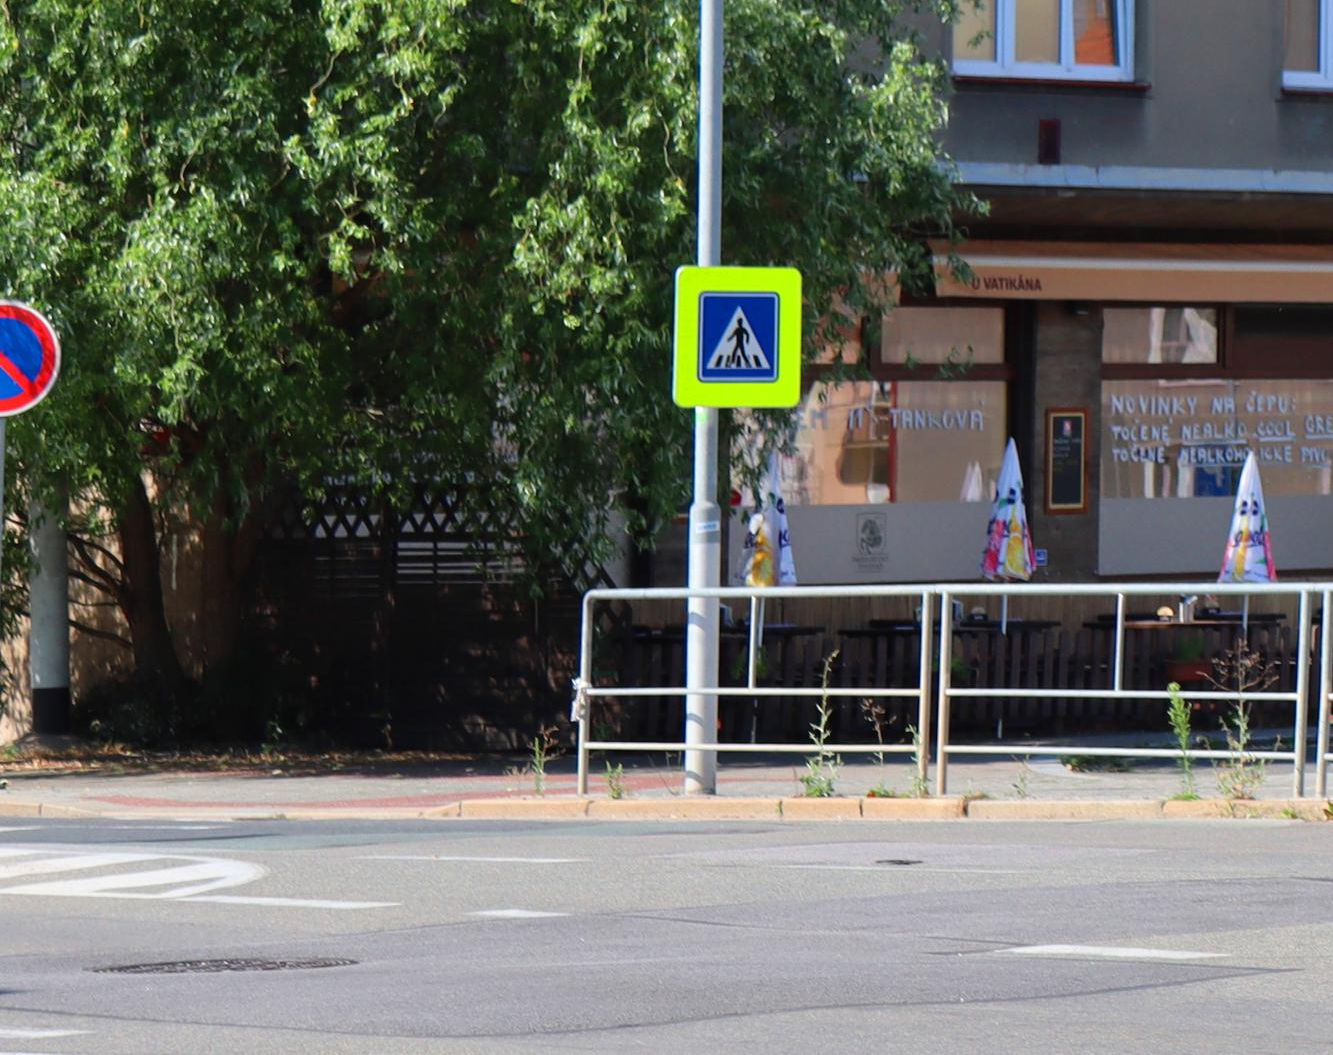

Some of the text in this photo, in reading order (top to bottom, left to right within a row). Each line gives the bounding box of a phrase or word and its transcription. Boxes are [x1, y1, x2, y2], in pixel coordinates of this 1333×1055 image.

[970, 274, 1042, 291] U VATIKÁNA
[1111, 395, 1198, 416] NOVINKY
[1212, 396, 1236, 414] NA
[1182, 421, 1248, 440] NEALKO
